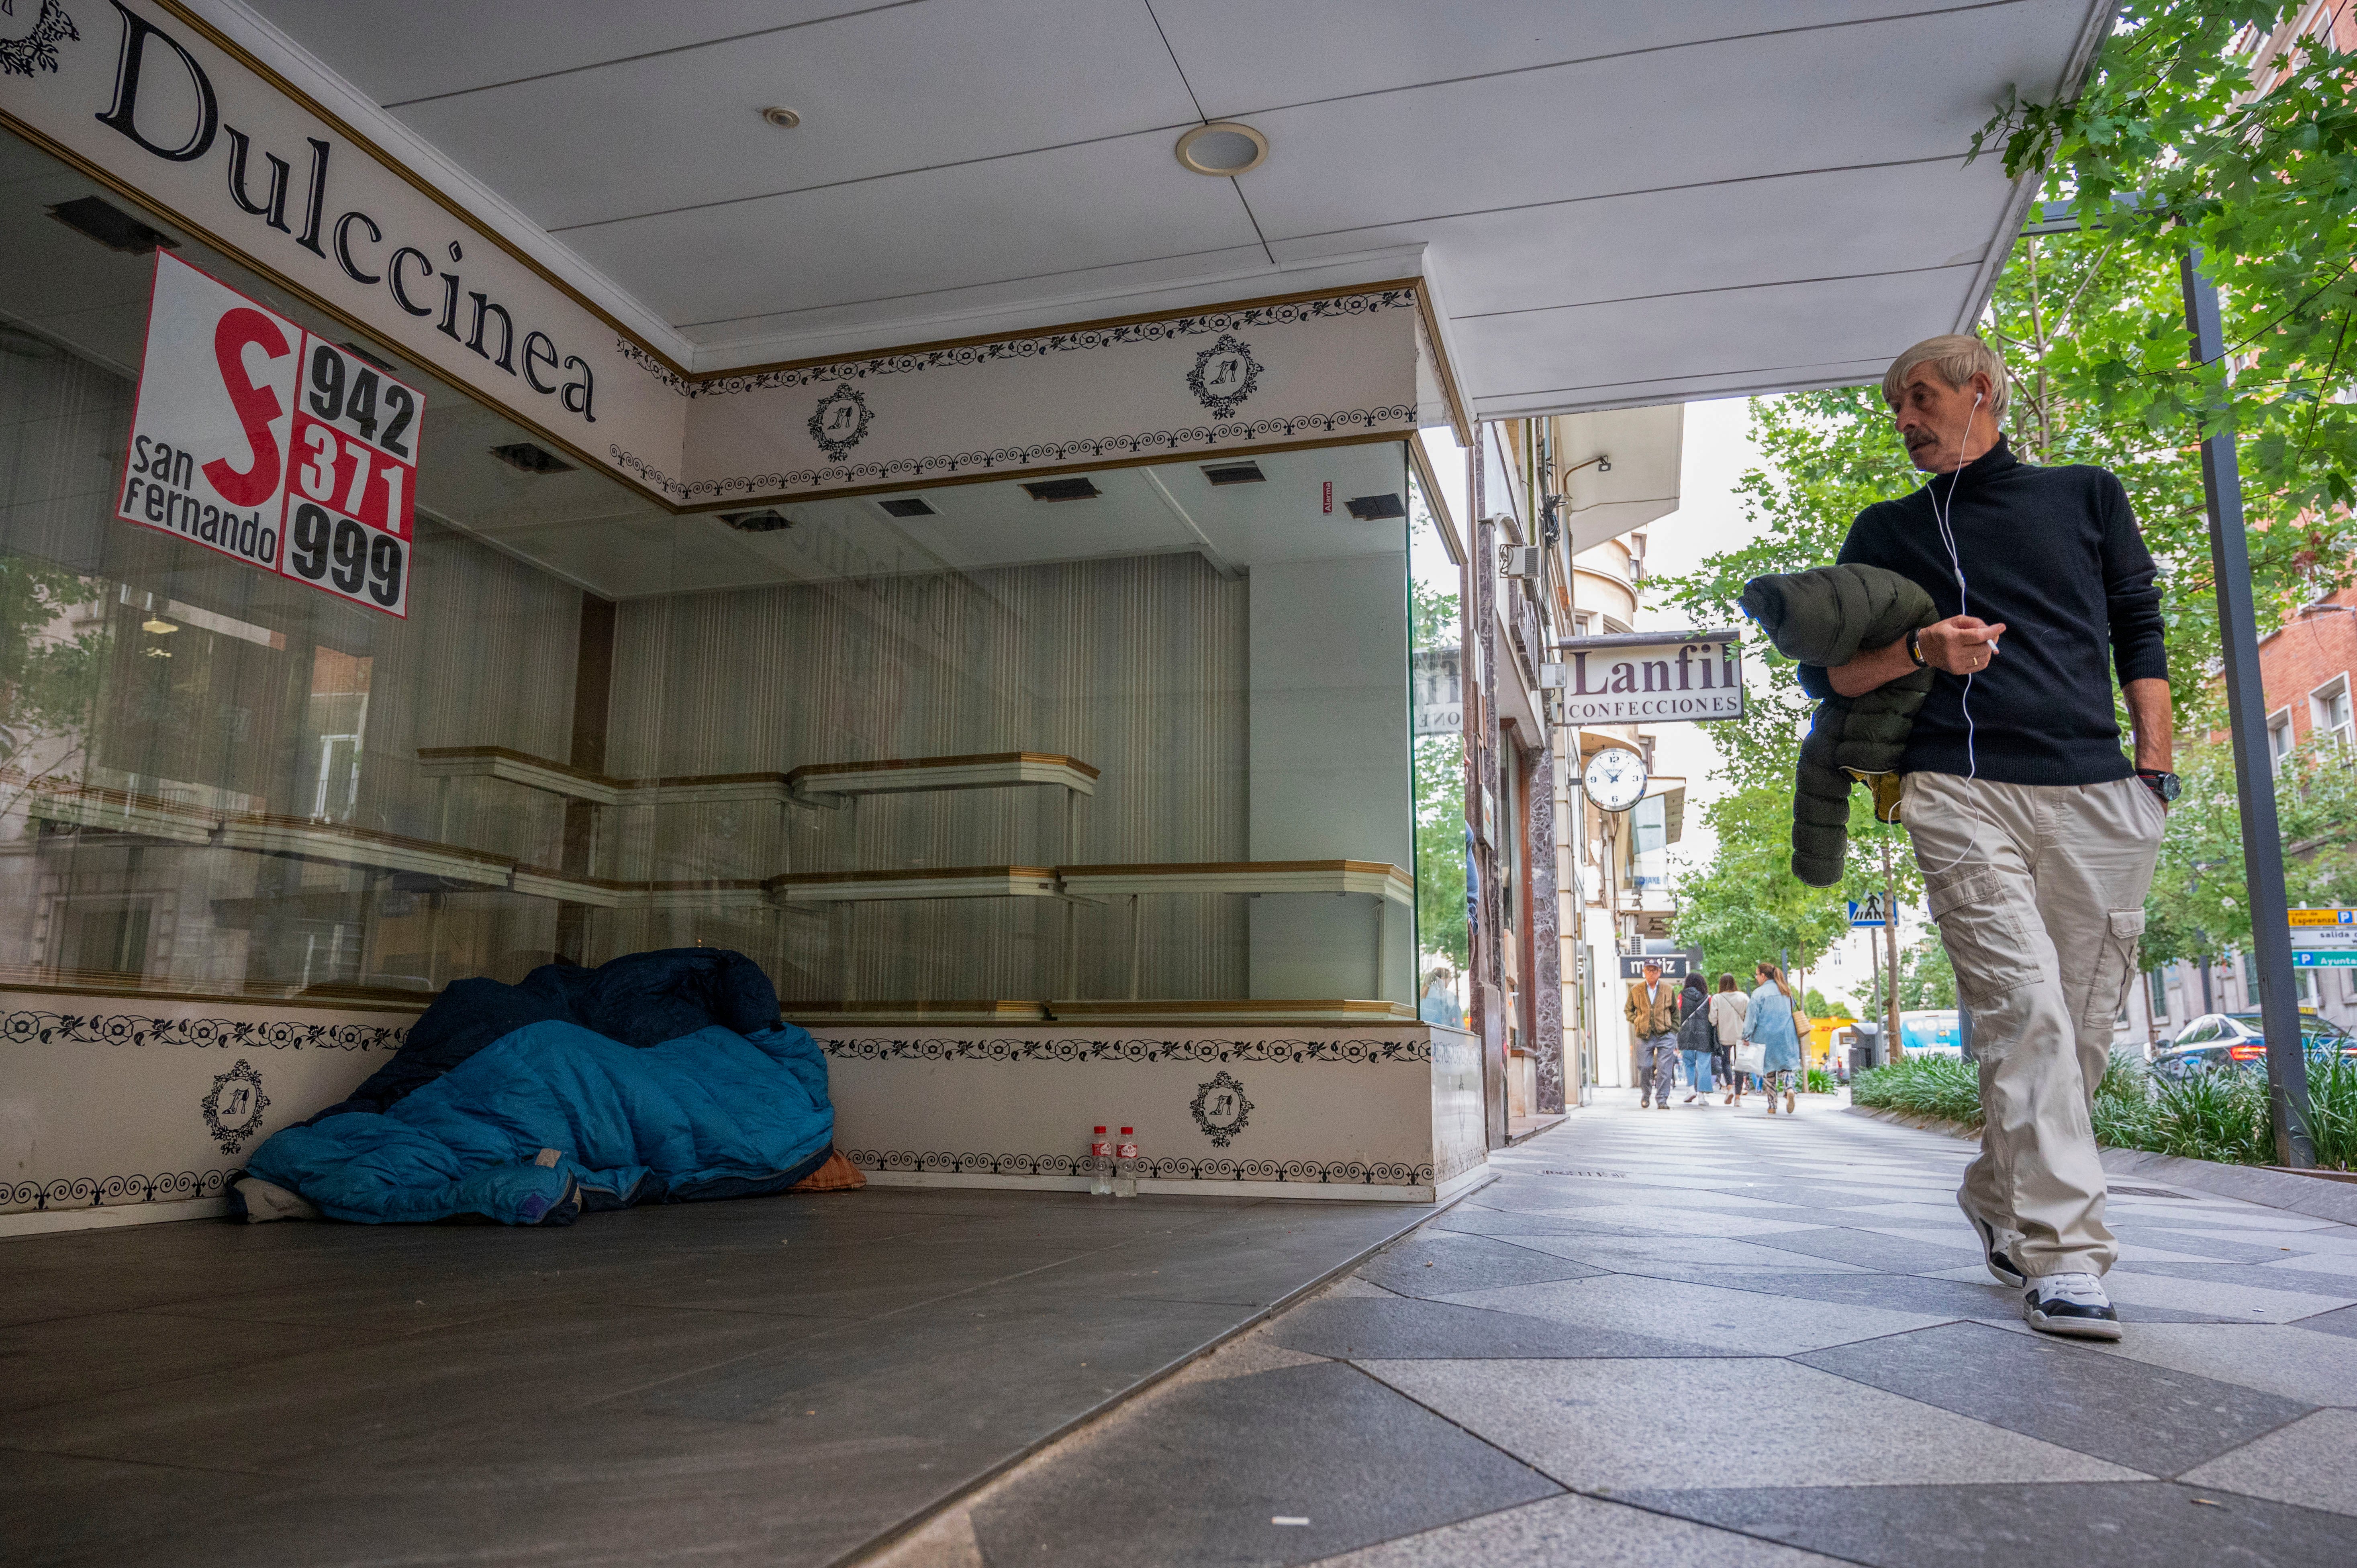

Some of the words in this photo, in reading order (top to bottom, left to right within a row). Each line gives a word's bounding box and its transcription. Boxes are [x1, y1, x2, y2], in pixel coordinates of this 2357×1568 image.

[95, 0, 596, 423] Dulccinea
[309, 345, 415, 458] 942
[133, 435, 194, 491] san
[300, 423, 404, 534] 371
[123, 477, 276, 564] fernando
[292, 503, 402, 607] 999
[1569, 643, 1737, 696] Lanfil
[1569, 696, 1738, 719] CONFECCIONES
[2340, 911, 2350, 923] P
[2301, 954, 2311, 964] P
